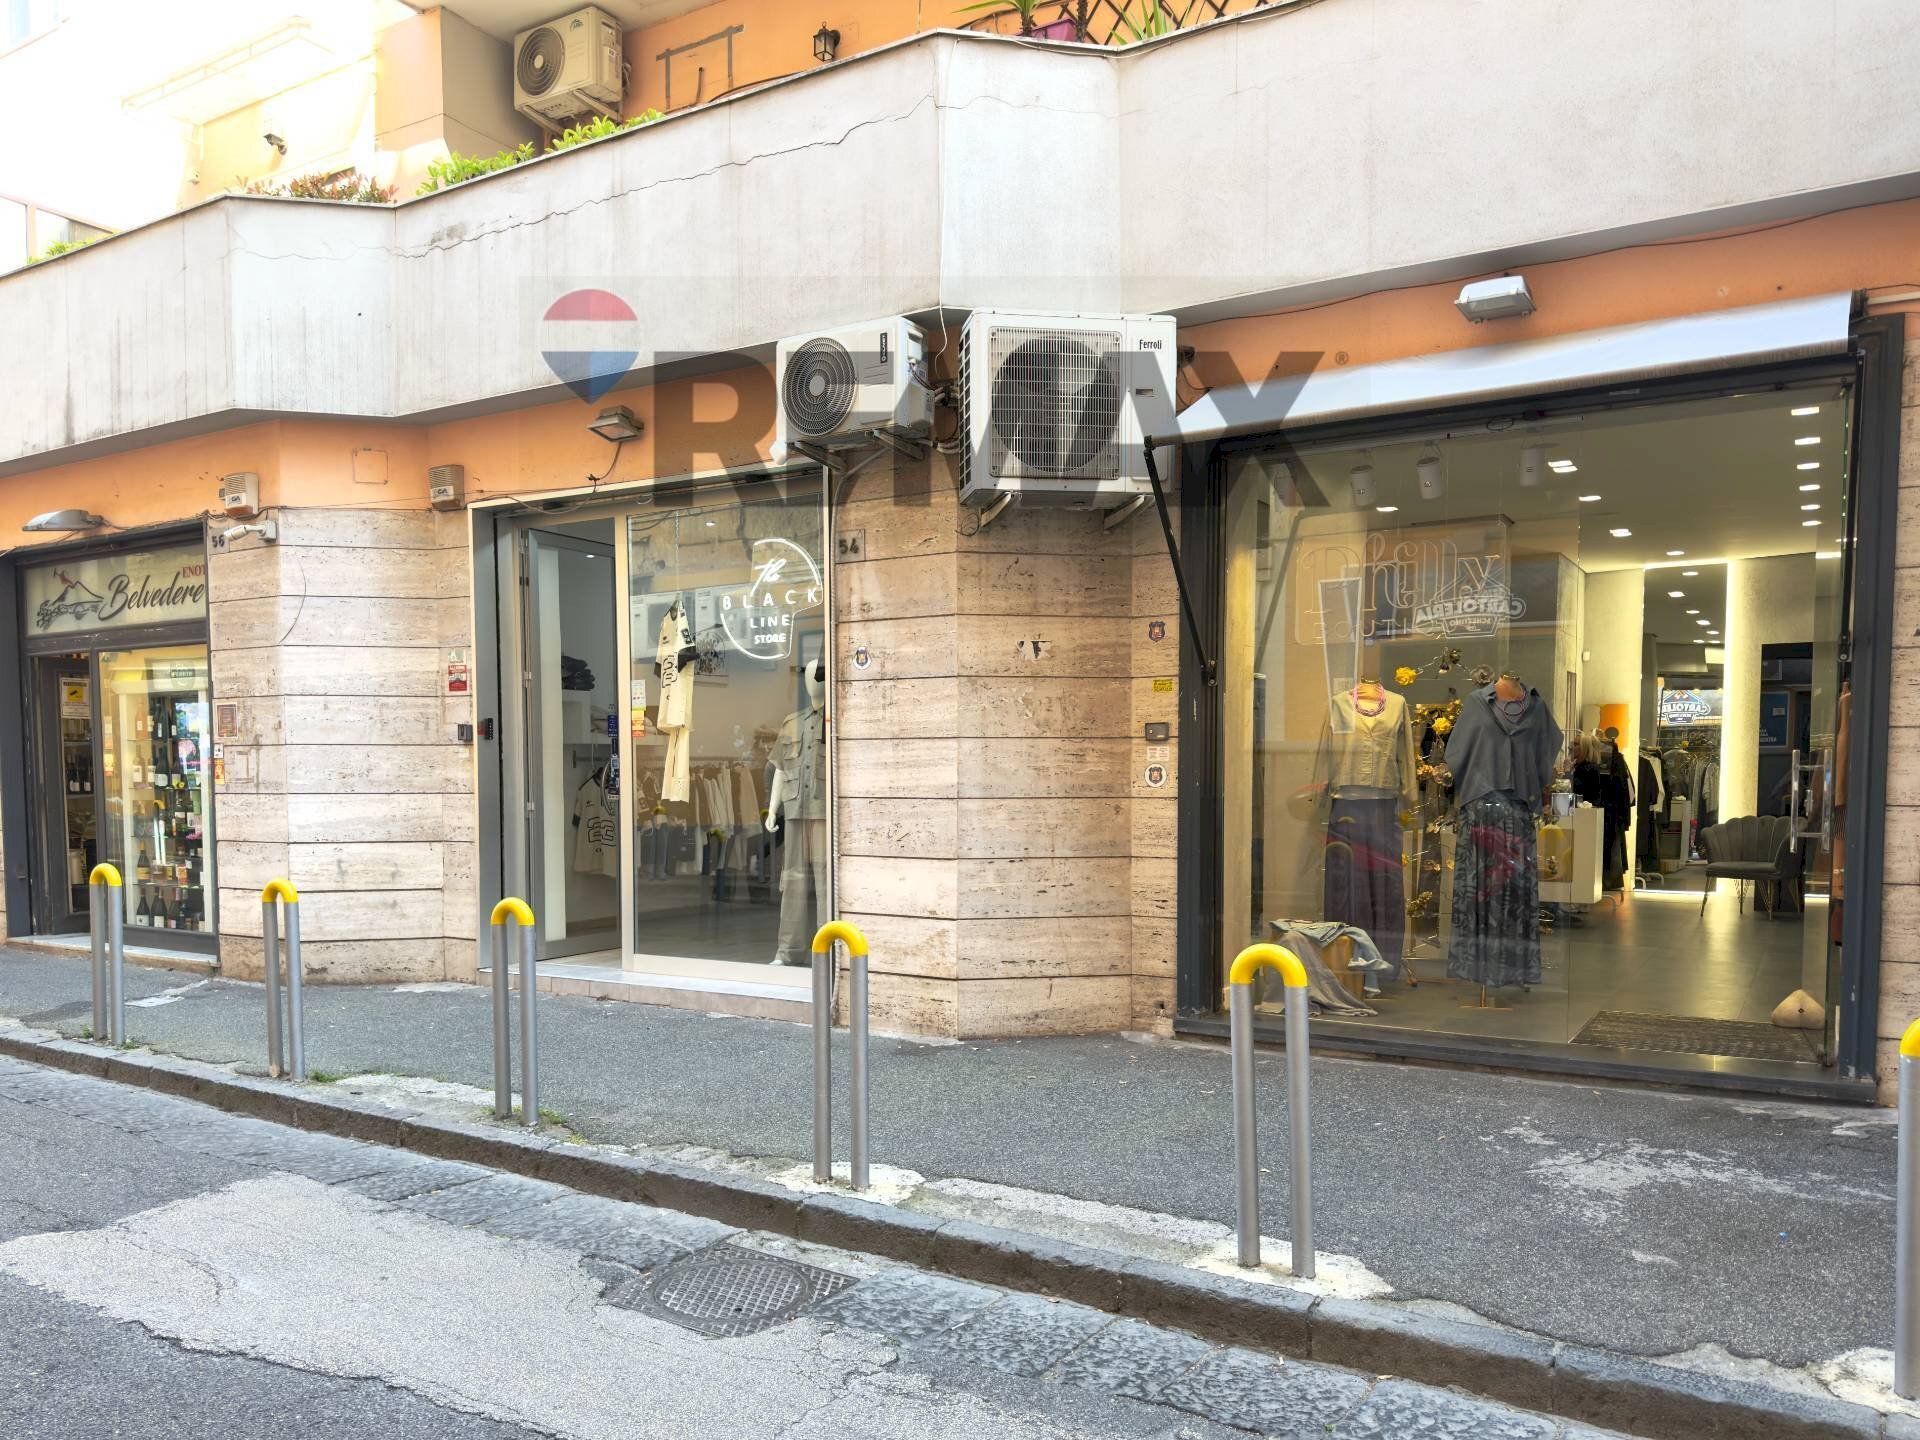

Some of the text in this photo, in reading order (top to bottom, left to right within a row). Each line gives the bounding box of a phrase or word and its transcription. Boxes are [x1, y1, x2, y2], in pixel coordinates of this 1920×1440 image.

[1139, 339, 1162, 350] Ferroli
[211, 534, 225, 548] 56
[98, 571, 206, 621] Belvedere
[722, 588, 818, 610] BLACK
[750, 614, 791, 629] LINE
[754, 632, 787, 645] STORE
